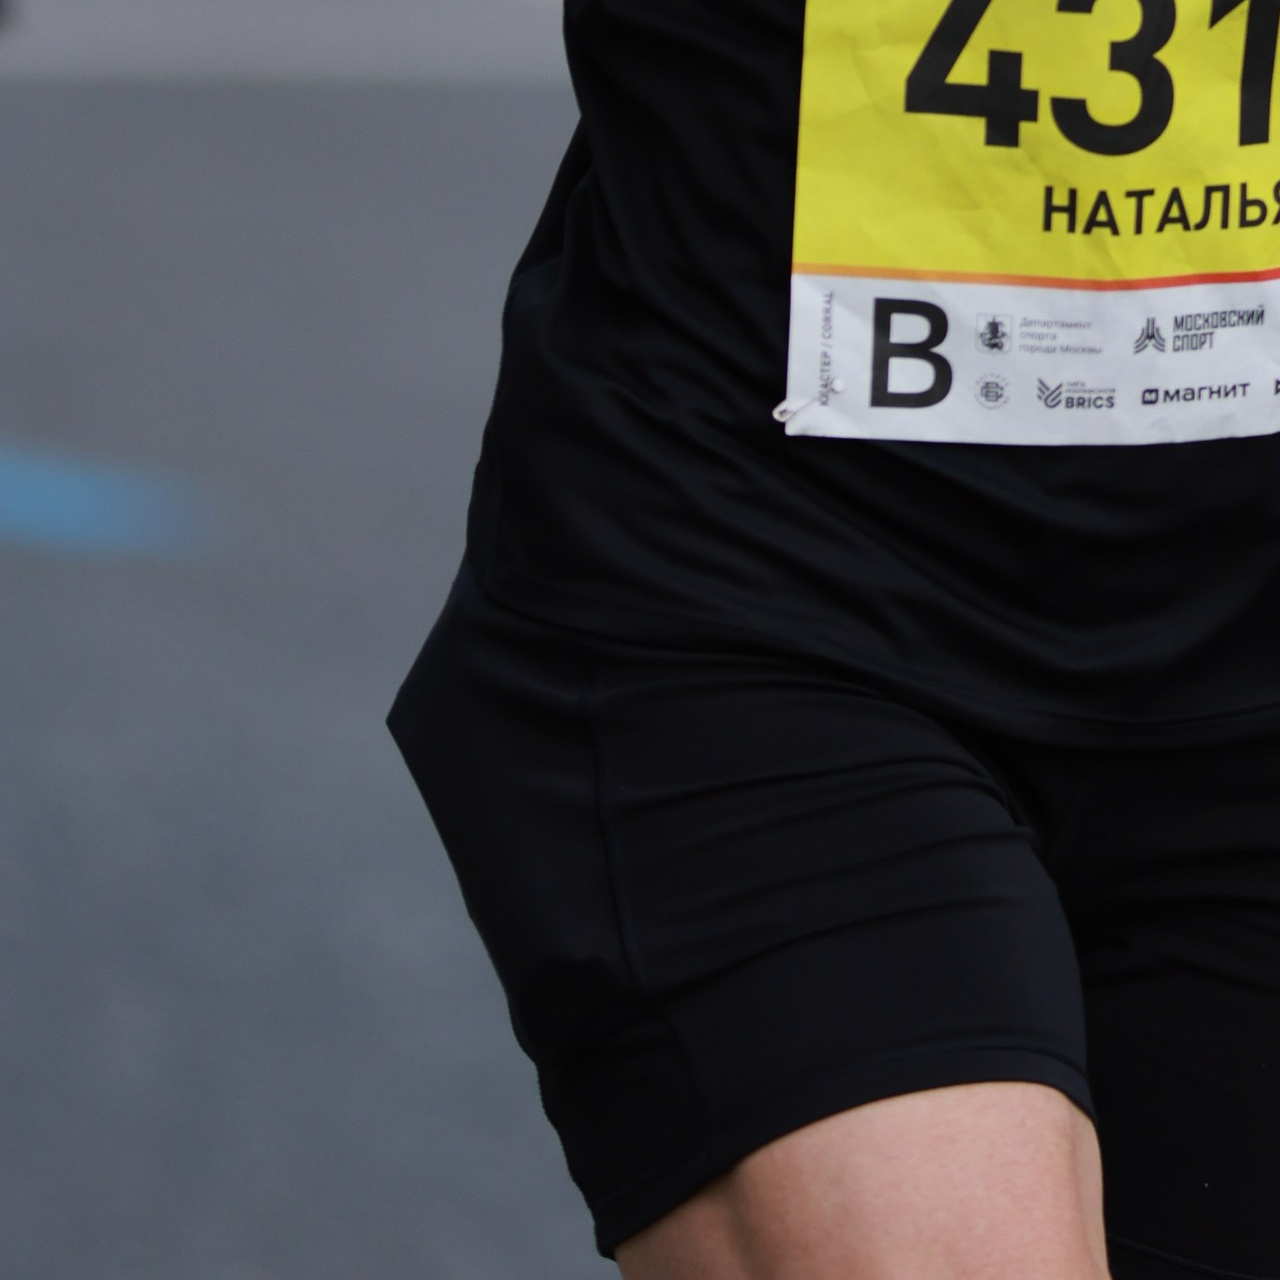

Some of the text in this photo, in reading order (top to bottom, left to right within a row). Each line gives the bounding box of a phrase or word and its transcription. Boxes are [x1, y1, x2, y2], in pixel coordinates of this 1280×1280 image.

[1173, 304, 1265, 333] МОСКОВСКИЙ
[1172, 331, 1214, 352] СПОРТ
[869, 297, 953, 409] B
[1065, 396, 1115, 409] BRICS
[1162, 382, 1250, 403] магнит
